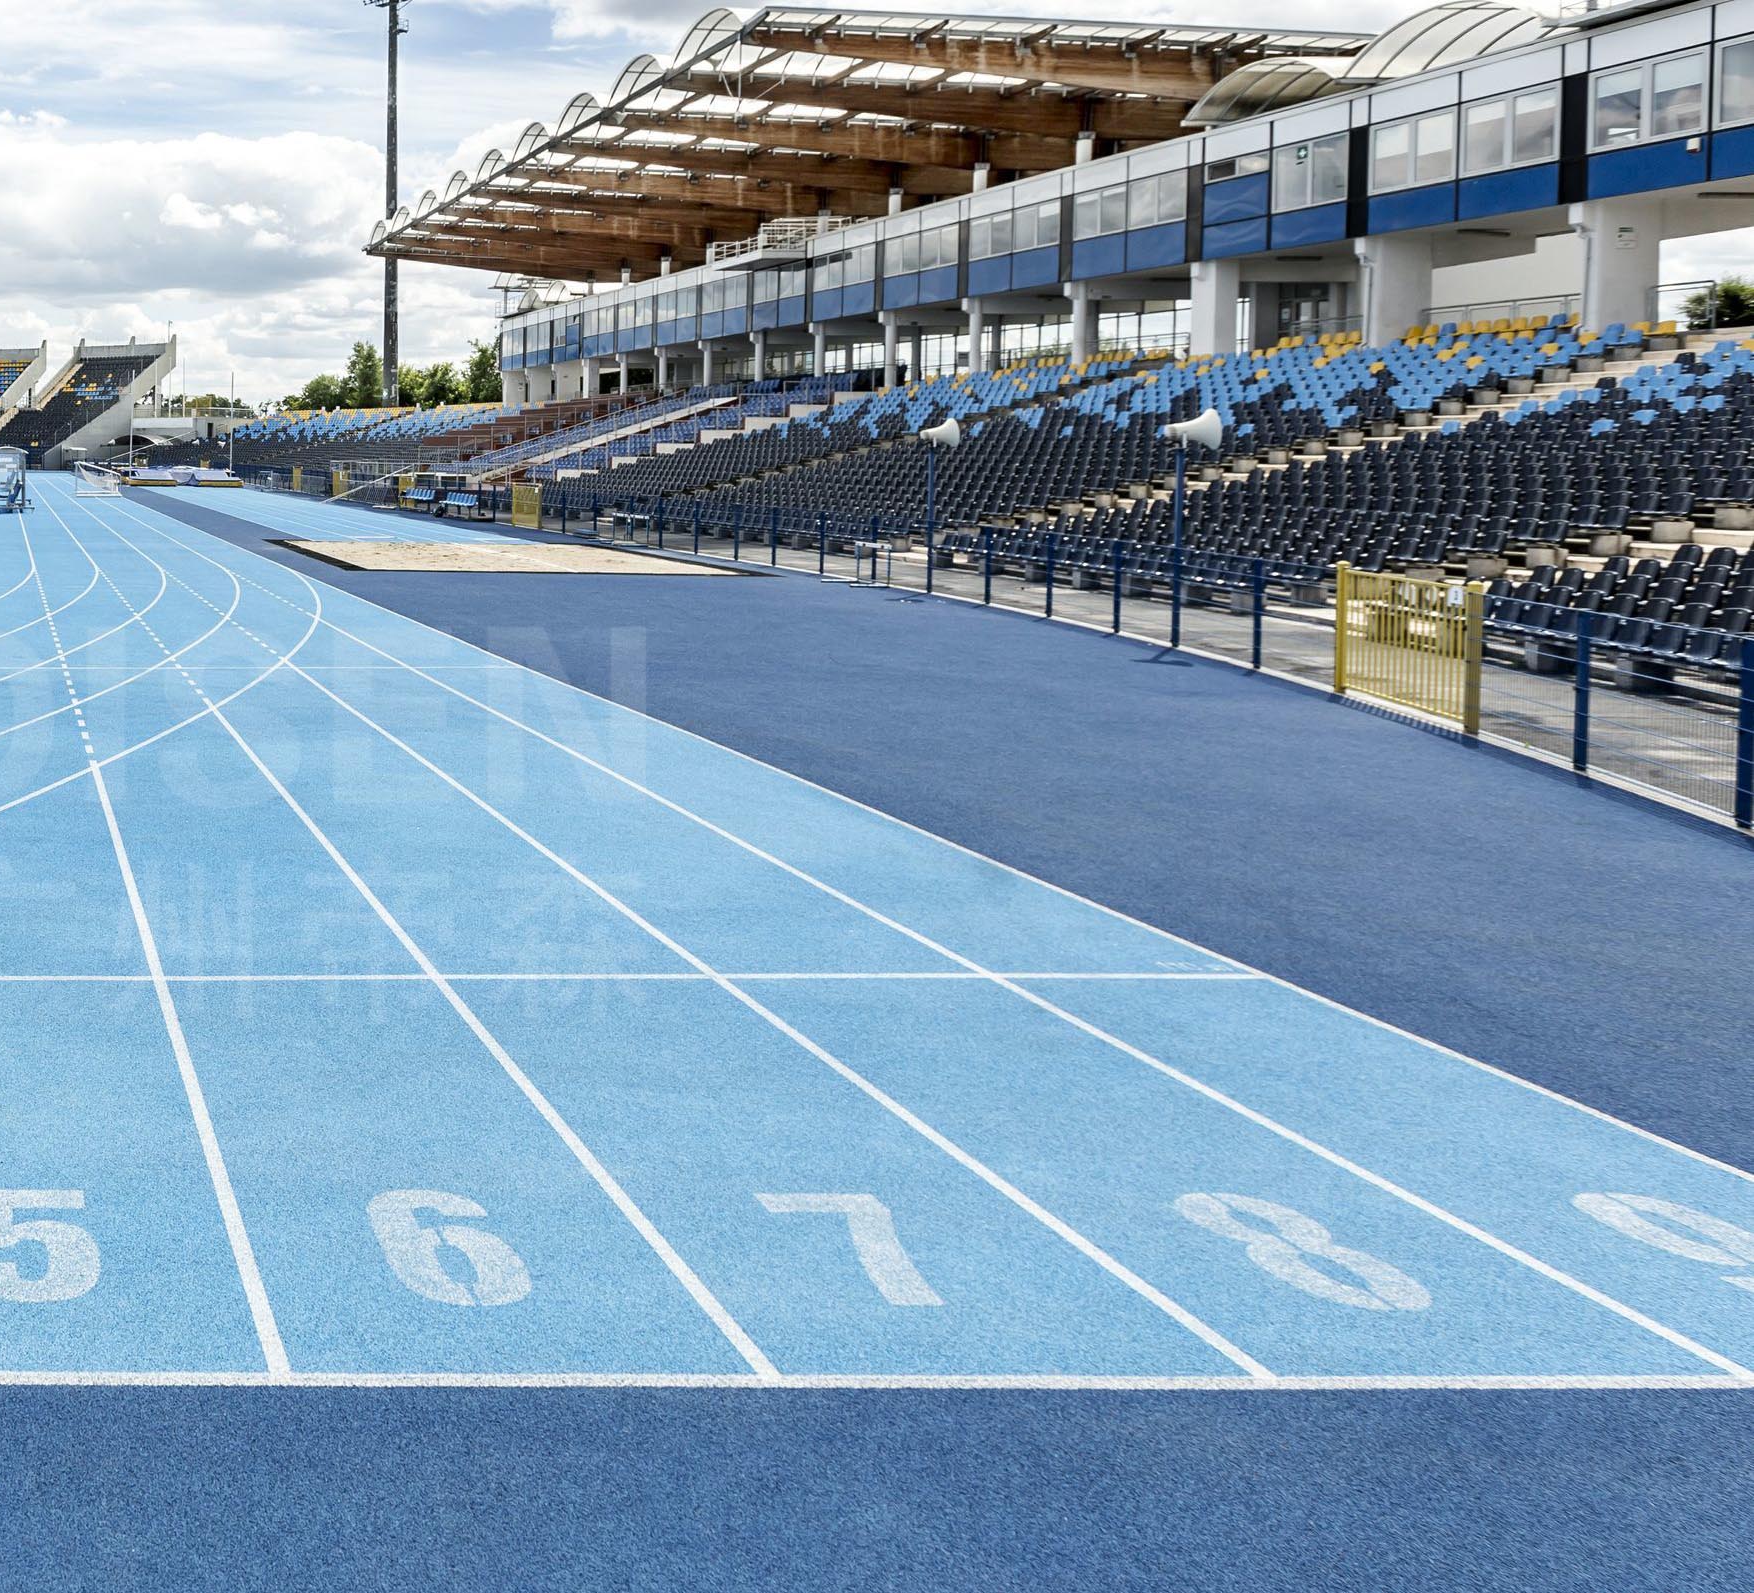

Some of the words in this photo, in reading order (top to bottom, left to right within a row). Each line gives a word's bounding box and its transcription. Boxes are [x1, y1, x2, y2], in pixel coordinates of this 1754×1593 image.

[365, 1188, 533, 1307] 6
[753, 1192, 945, 1306] 7
[1173, 1191, 1433, 1311] 8
